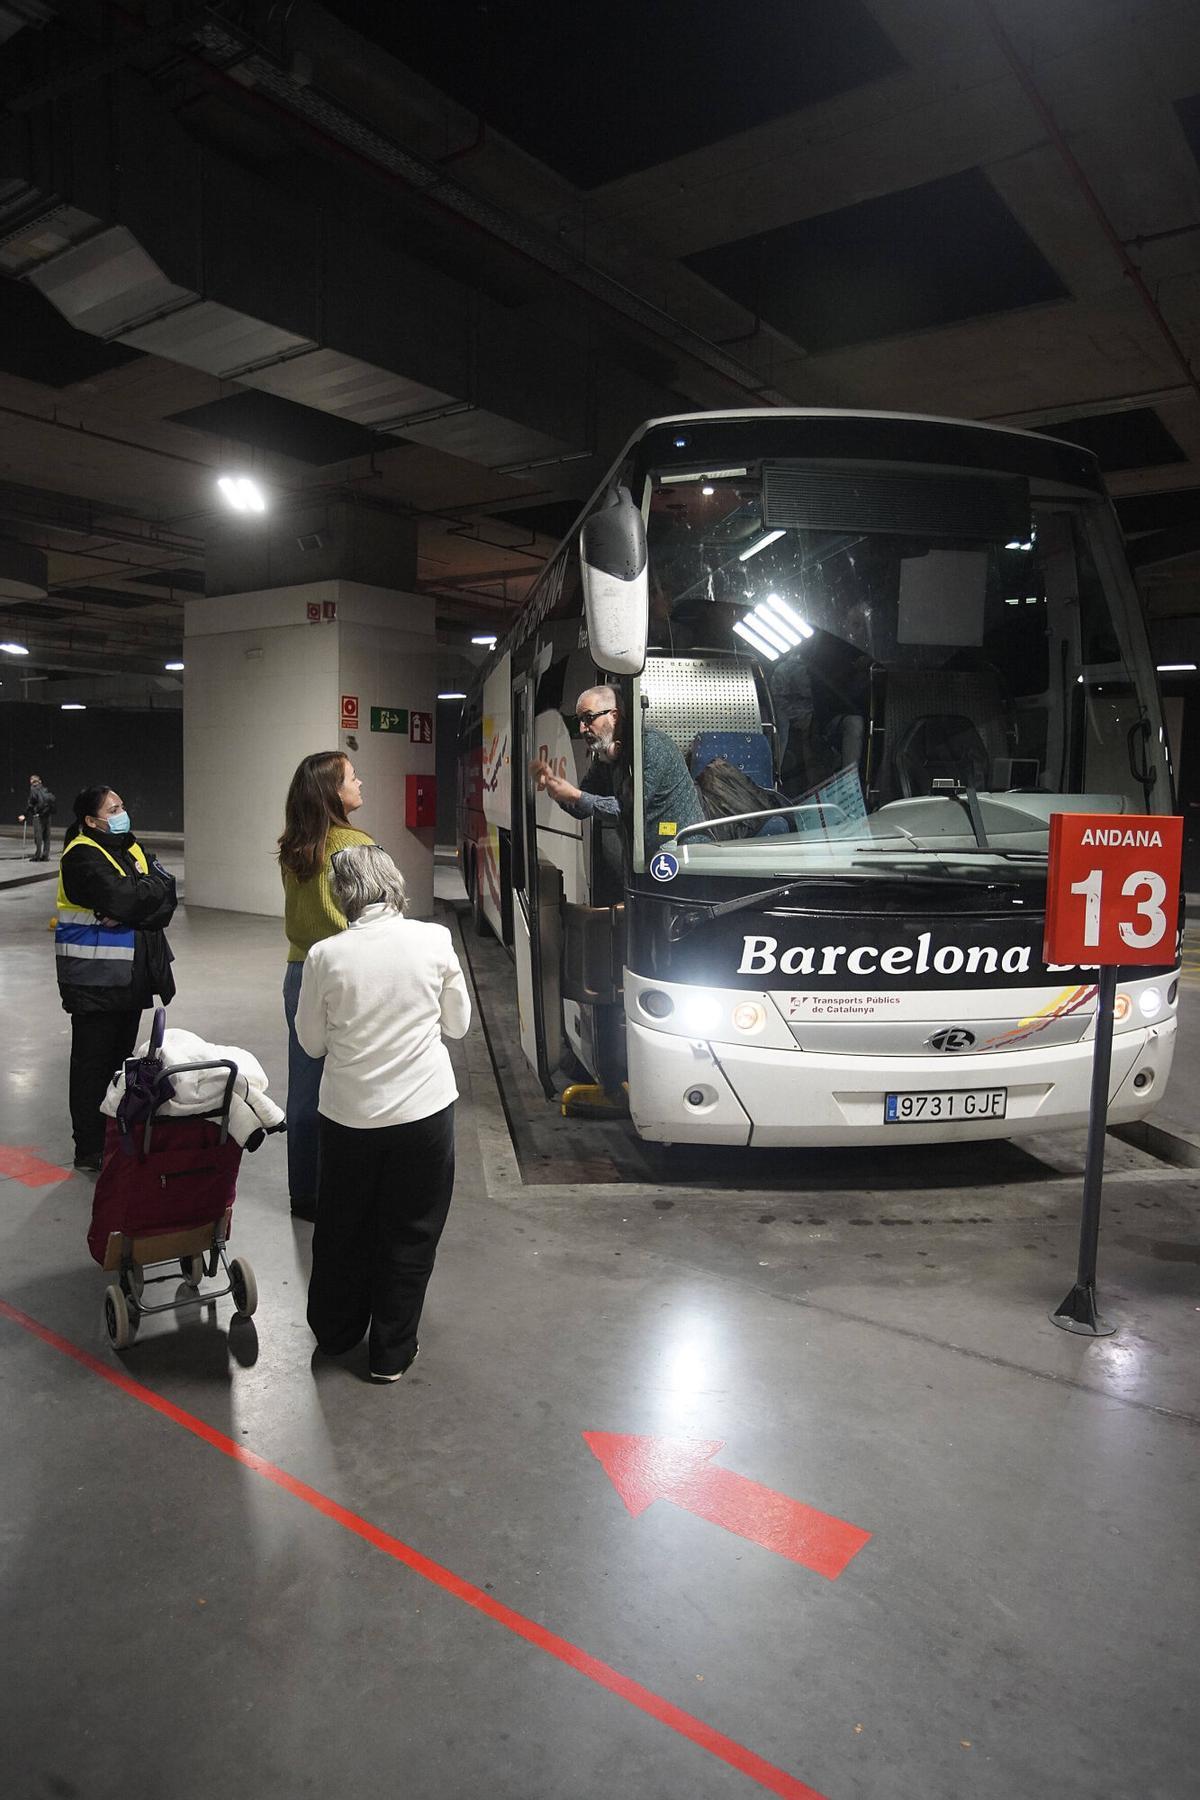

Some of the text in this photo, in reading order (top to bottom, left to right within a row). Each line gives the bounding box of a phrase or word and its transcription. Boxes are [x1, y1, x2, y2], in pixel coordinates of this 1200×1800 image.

[1080, 828, 1163, 848] ANDANA
[1070, 869, 1167, 949] 13
[736, 932, 1032, 976] Barcelona
[812, 996, 901, 1006] Transports Públics
[812, 1005, 875, 1015] de Catalunya
[901, 1096, 954, 1118] 9731
[964, 1093, 1003, 1115] GJF
